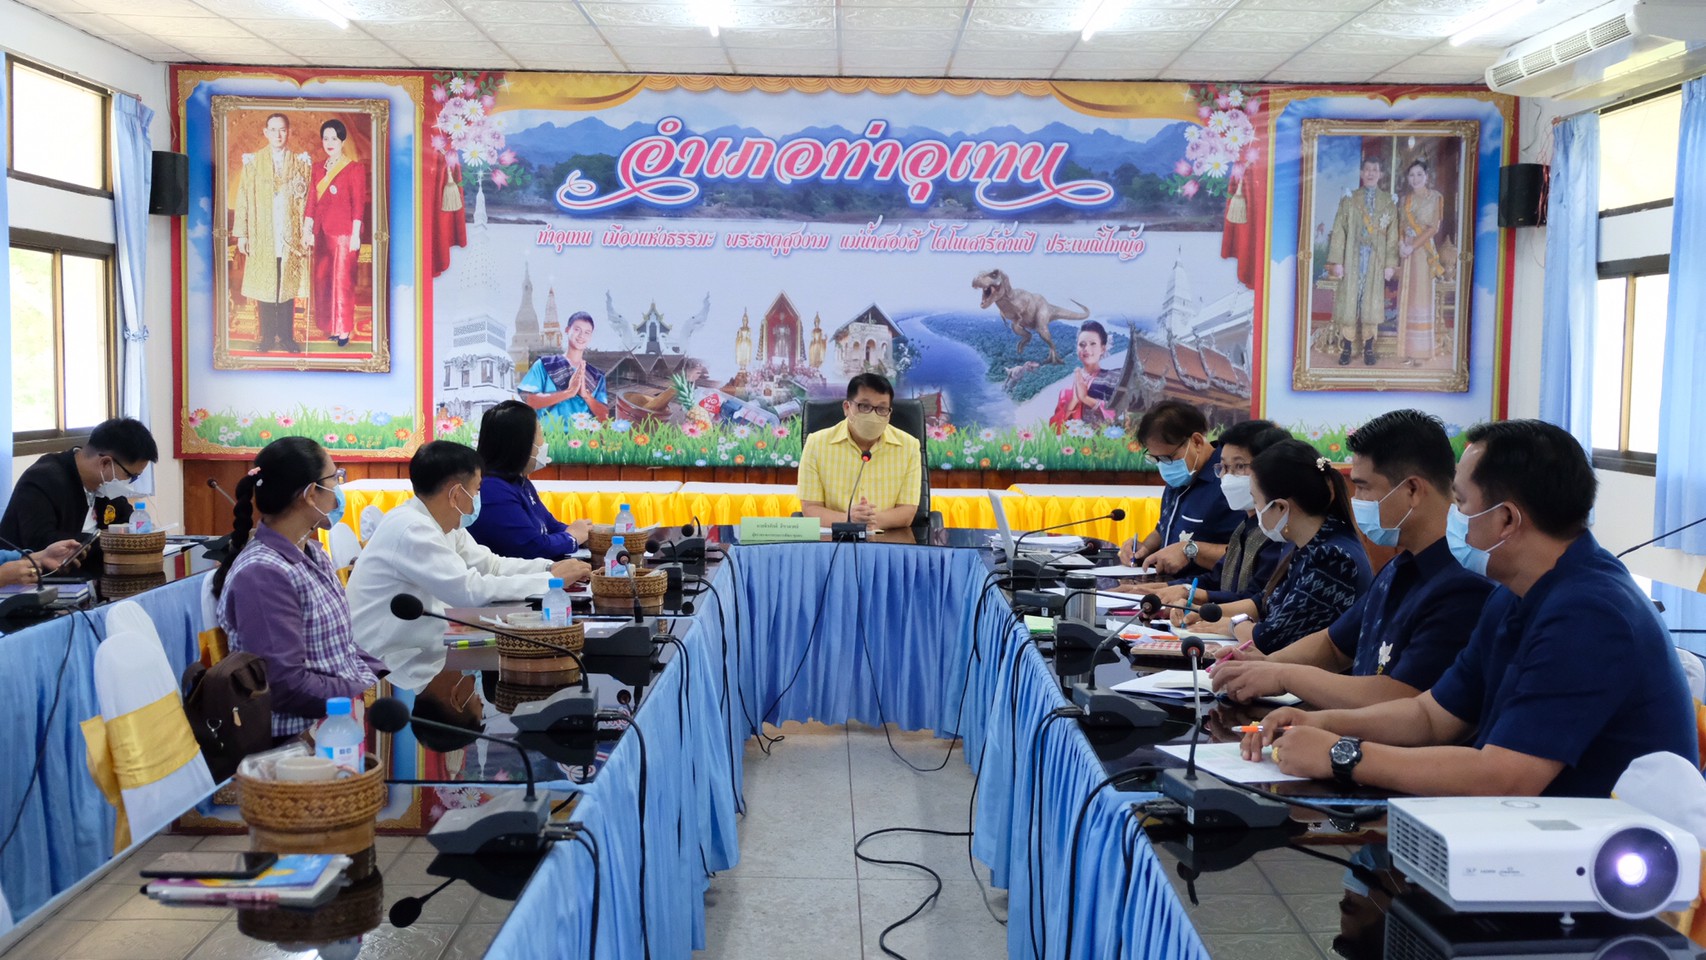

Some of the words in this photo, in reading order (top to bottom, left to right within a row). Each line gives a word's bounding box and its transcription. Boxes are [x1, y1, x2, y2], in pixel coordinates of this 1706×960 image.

[556, 116, 1115, 210] อำเภอท่าอุเทน
[537, 224, 592, 253] ท่าอุเทน
[602, 224, 716, 248] เมืองแห่งธรรมะ
[726, 223, 829, 256] พระธาตุสูงงาม
[840, 216, 926, 252] แม่น้ำสองสี
[930, 221, 1037, 252] ไดโนเสาร์ล้านปี
